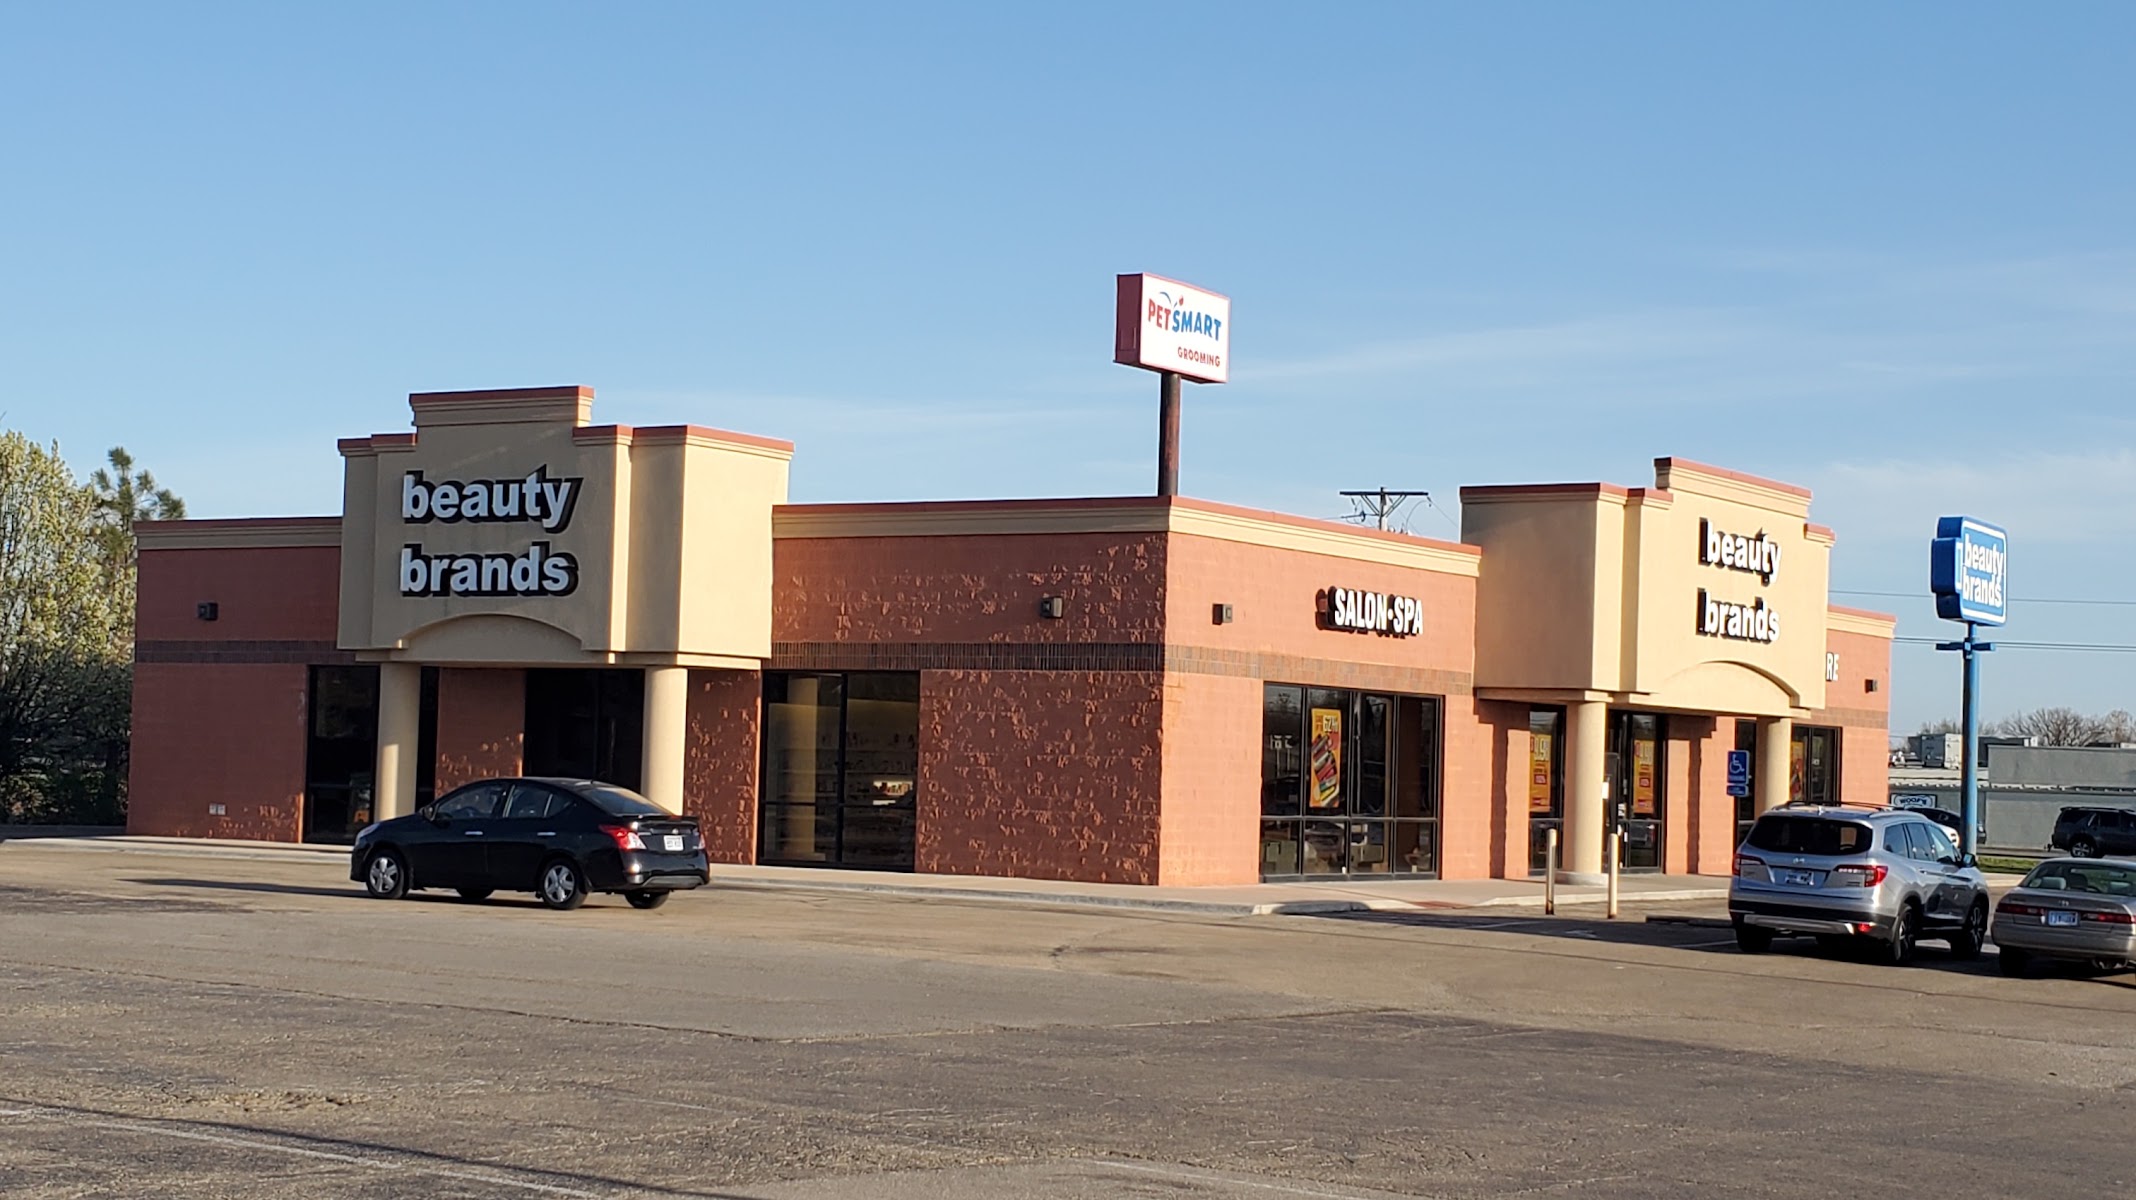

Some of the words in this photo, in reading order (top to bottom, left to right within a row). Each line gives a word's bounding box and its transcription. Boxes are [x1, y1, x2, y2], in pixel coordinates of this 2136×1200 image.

[1147, 298, 1222, 342] PETSMART
[1177, 346, 1221, 367] GROOMING
[402, 470, 573, 530] beauty
[400, 545, 571, 593] brands
[1706, 519, 1782, 584] beauty
[1964, 533, 2004, 581] beauty
[1962, 566, 2003, 608] brands
[1704, 590, 1781, 642] brands
